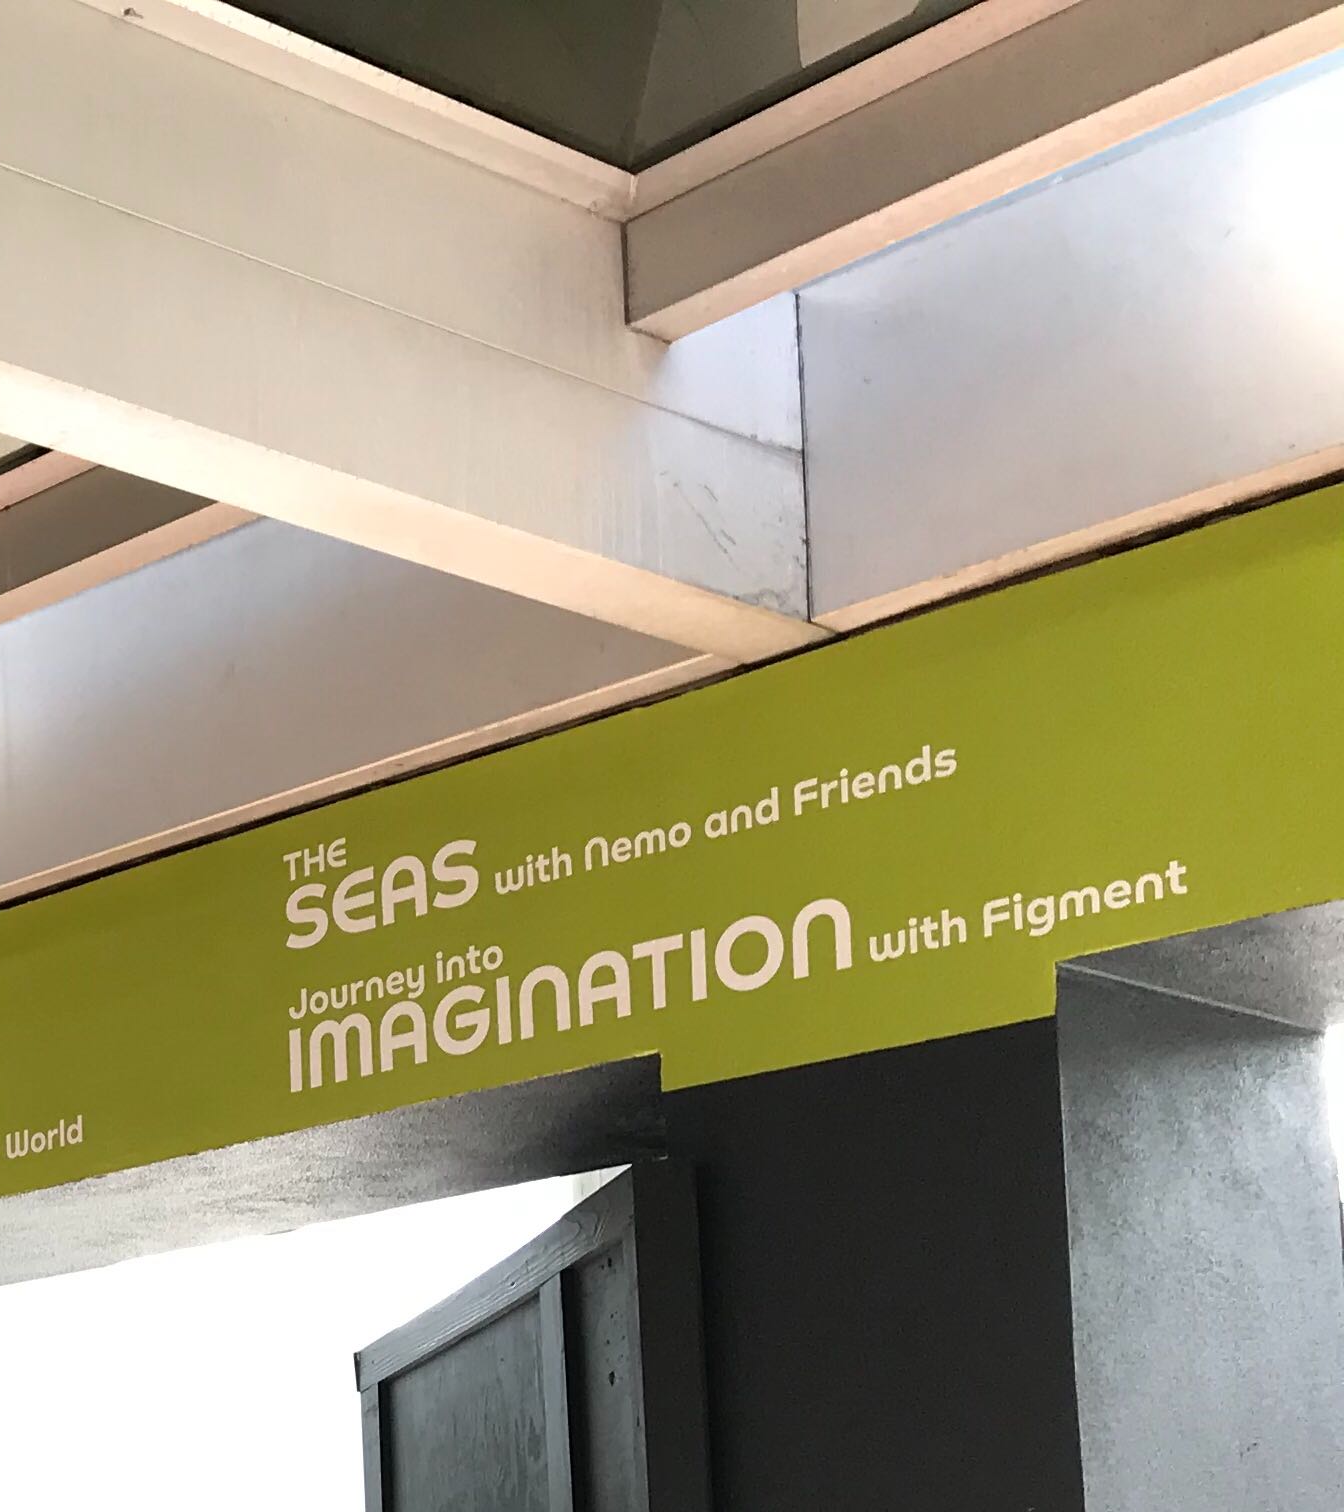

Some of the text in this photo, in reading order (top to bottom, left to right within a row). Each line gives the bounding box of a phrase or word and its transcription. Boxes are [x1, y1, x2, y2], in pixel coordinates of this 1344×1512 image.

[283, 837, 348, 882] THE
[285, 839, 480, 949] SEAS
[494, 846, 574, 895] with
[704, 786, 780, 839] and
[793, 744, 958, 817] Friends
[288, 858, 1189, 1093] IMAGINATION with Figment
[288, 944, 505, 1020] Journey into
[5, 1114, 84, 1160] World
